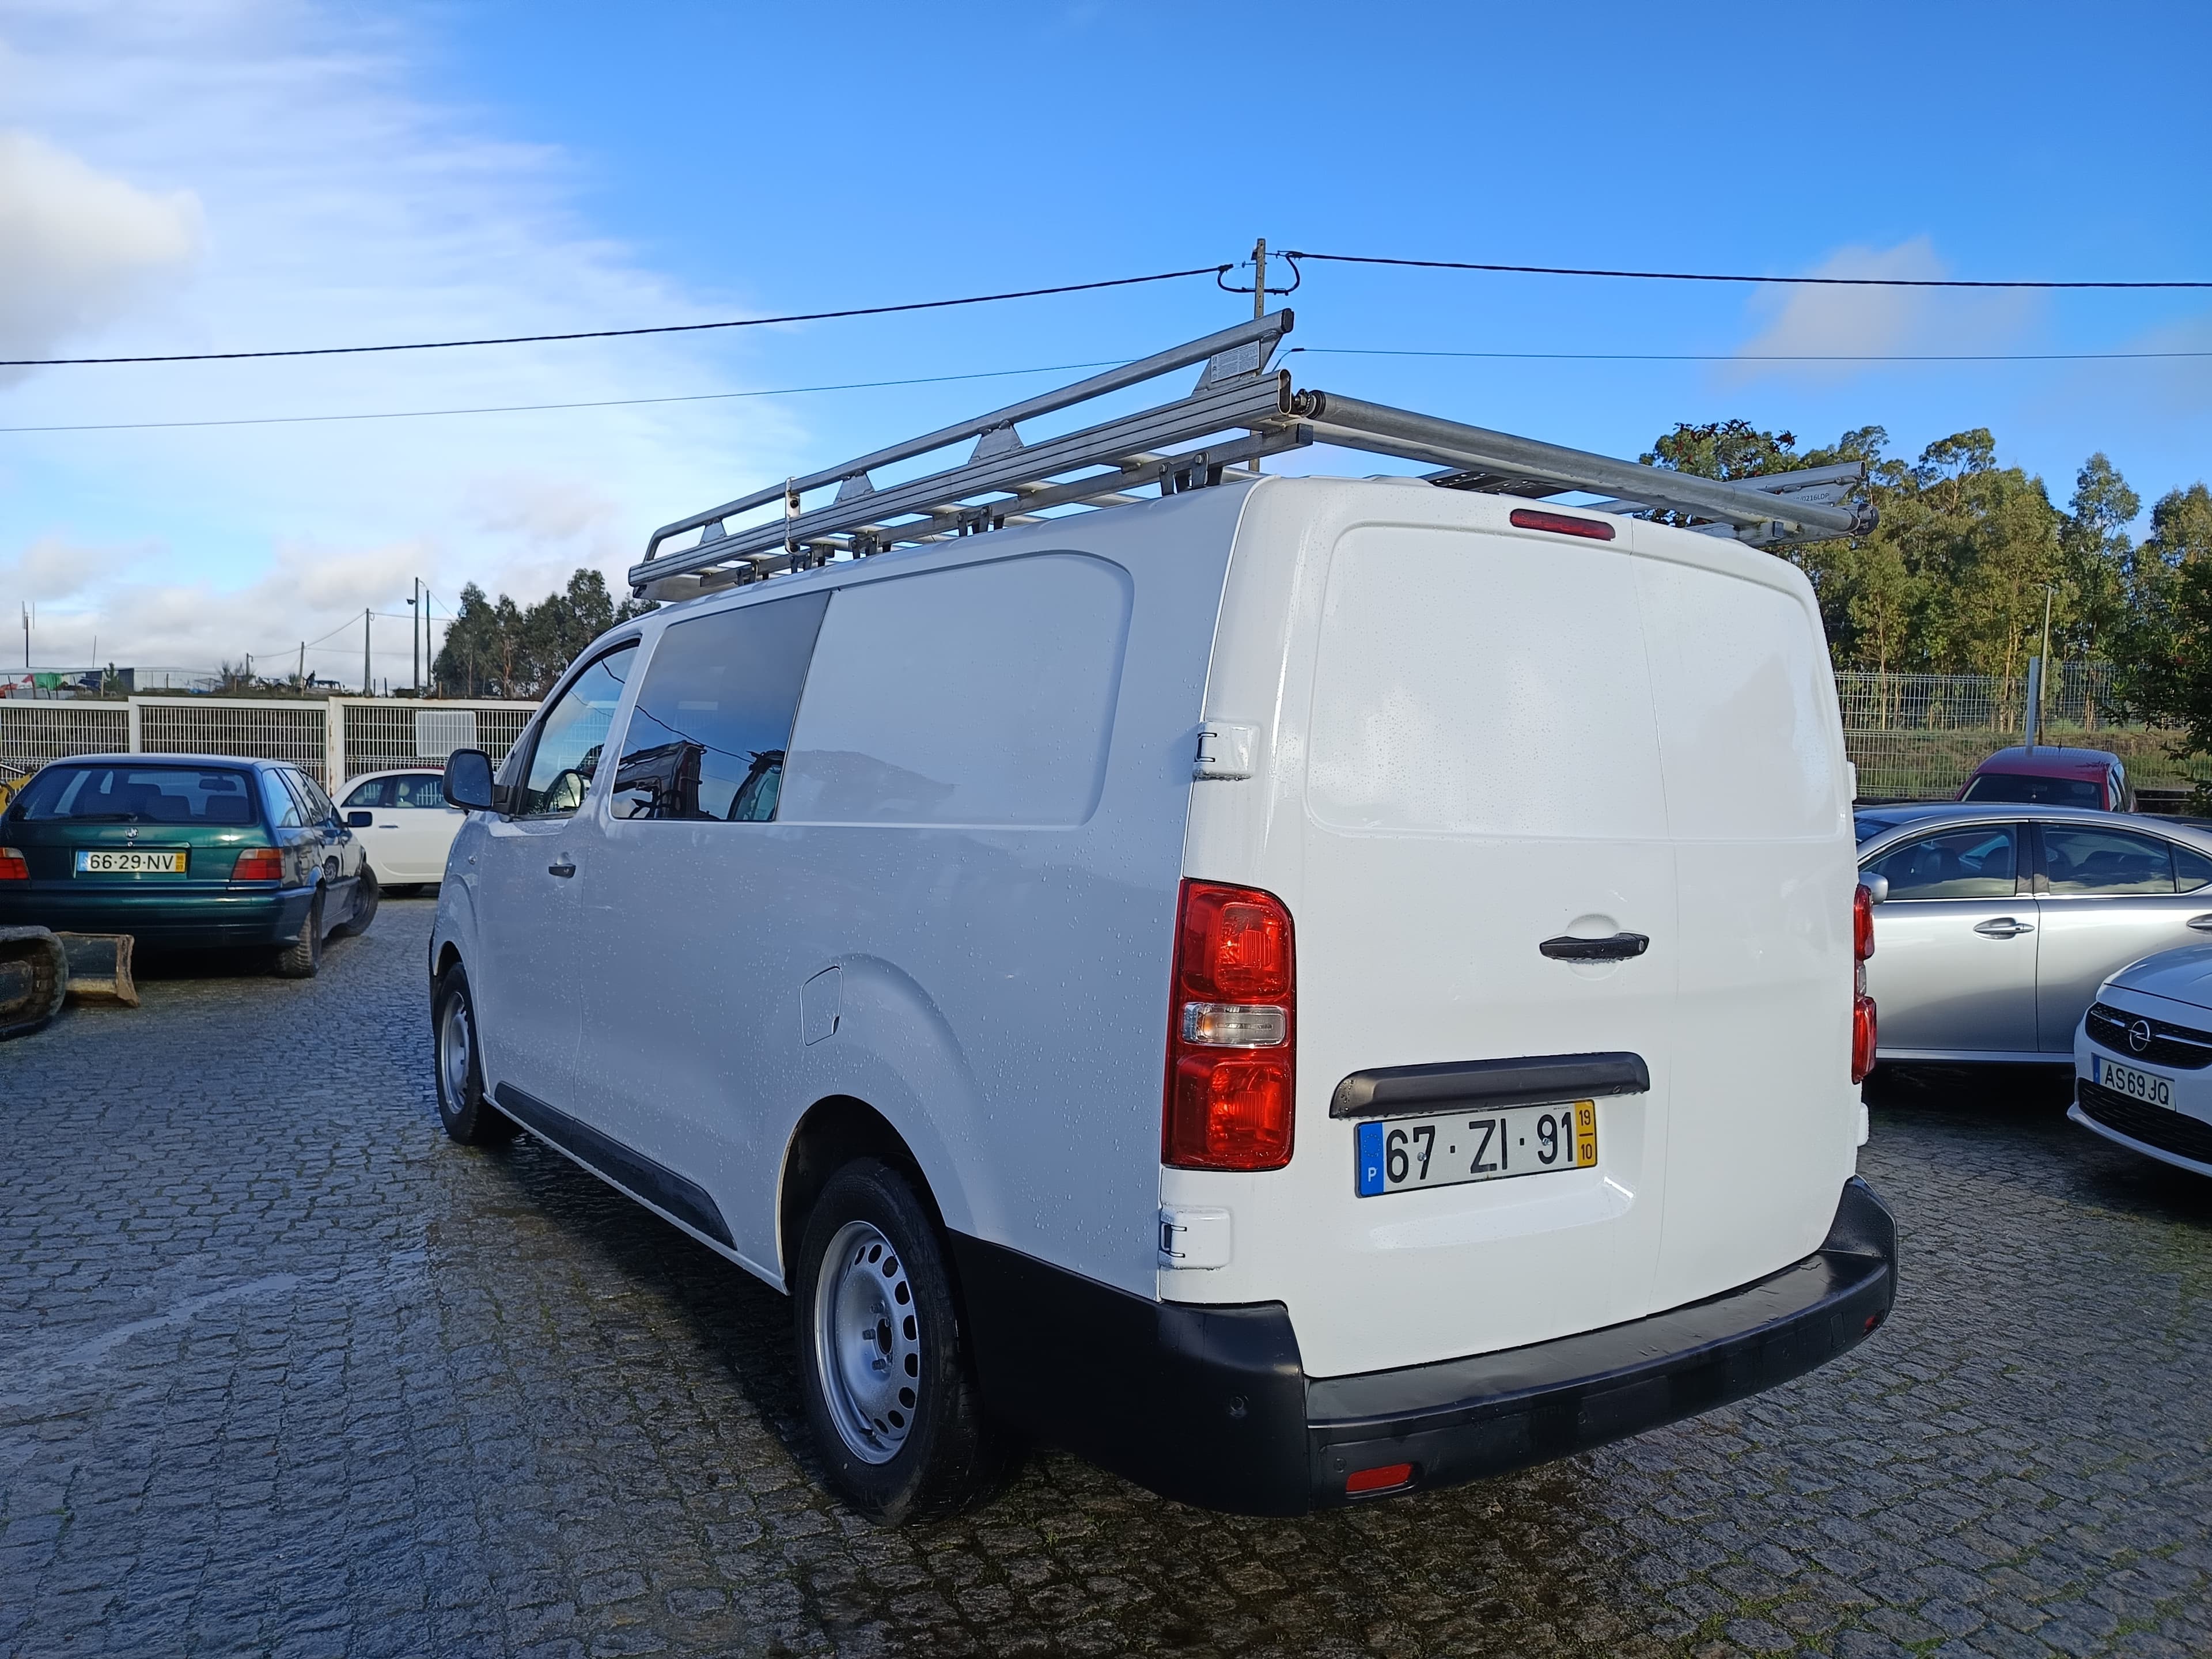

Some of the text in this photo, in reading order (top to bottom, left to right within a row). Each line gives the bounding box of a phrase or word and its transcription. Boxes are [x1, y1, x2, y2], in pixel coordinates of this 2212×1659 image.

[2105, 1065, 2169, 1105] AS69JQ
[1579, 1109, 1590, 1126] 19
[1581, 1143, 1592, 1160] 10
[1368, 1166, 1377, 1182] P
